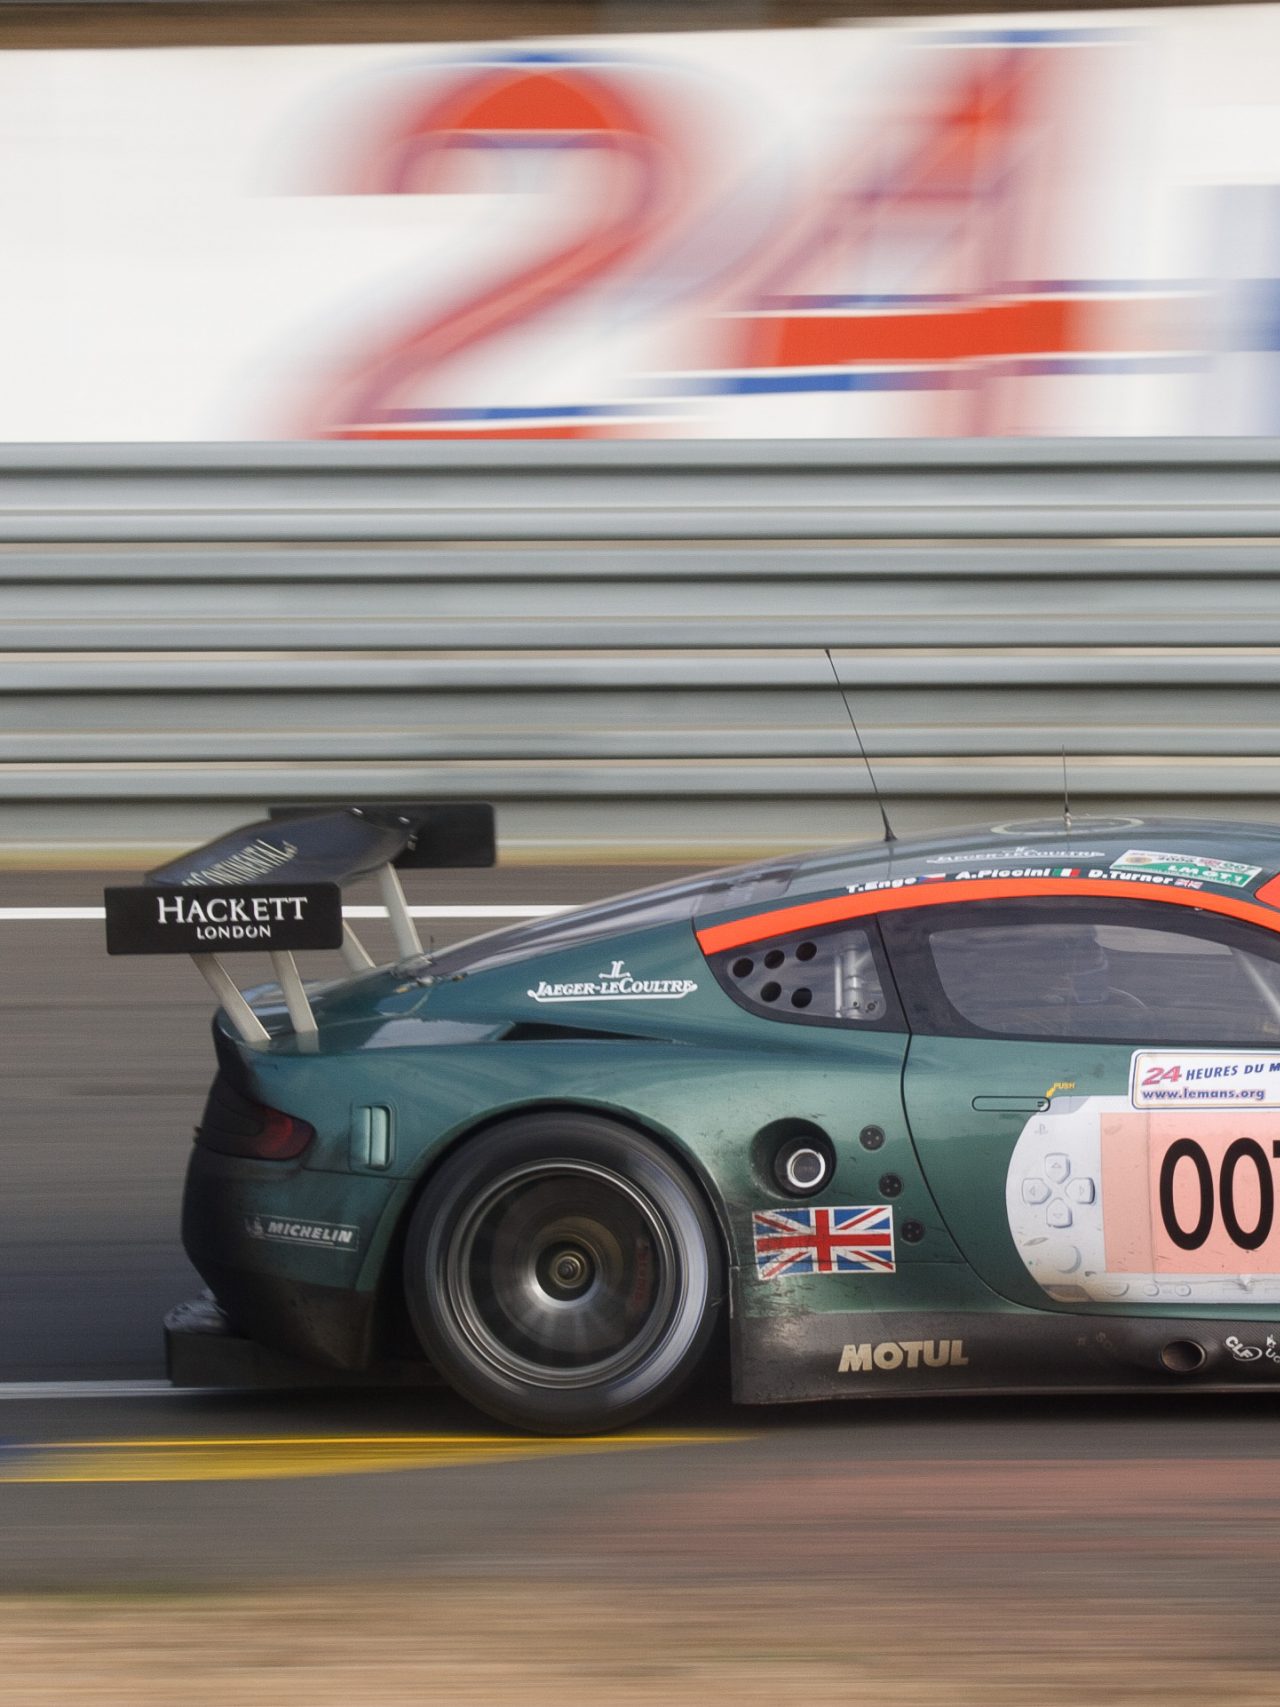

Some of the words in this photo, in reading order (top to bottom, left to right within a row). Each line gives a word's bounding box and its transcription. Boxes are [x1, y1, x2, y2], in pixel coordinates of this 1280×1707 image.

[157, 896, 307, 924] HACKETT
[197, 924, 271, 940] LONDON
[1142, 1066, 1182, 1086] 24
[1186, 1066, 1238, 1081] HEURES
[1244, 1063, 1265, 1074] DU
[1142, 1088, 1265, 1100] www.lemans.org
[268, 1222, 353, 1243] MICHELIN
[838, 1340, 969, 1372] MOTUL
